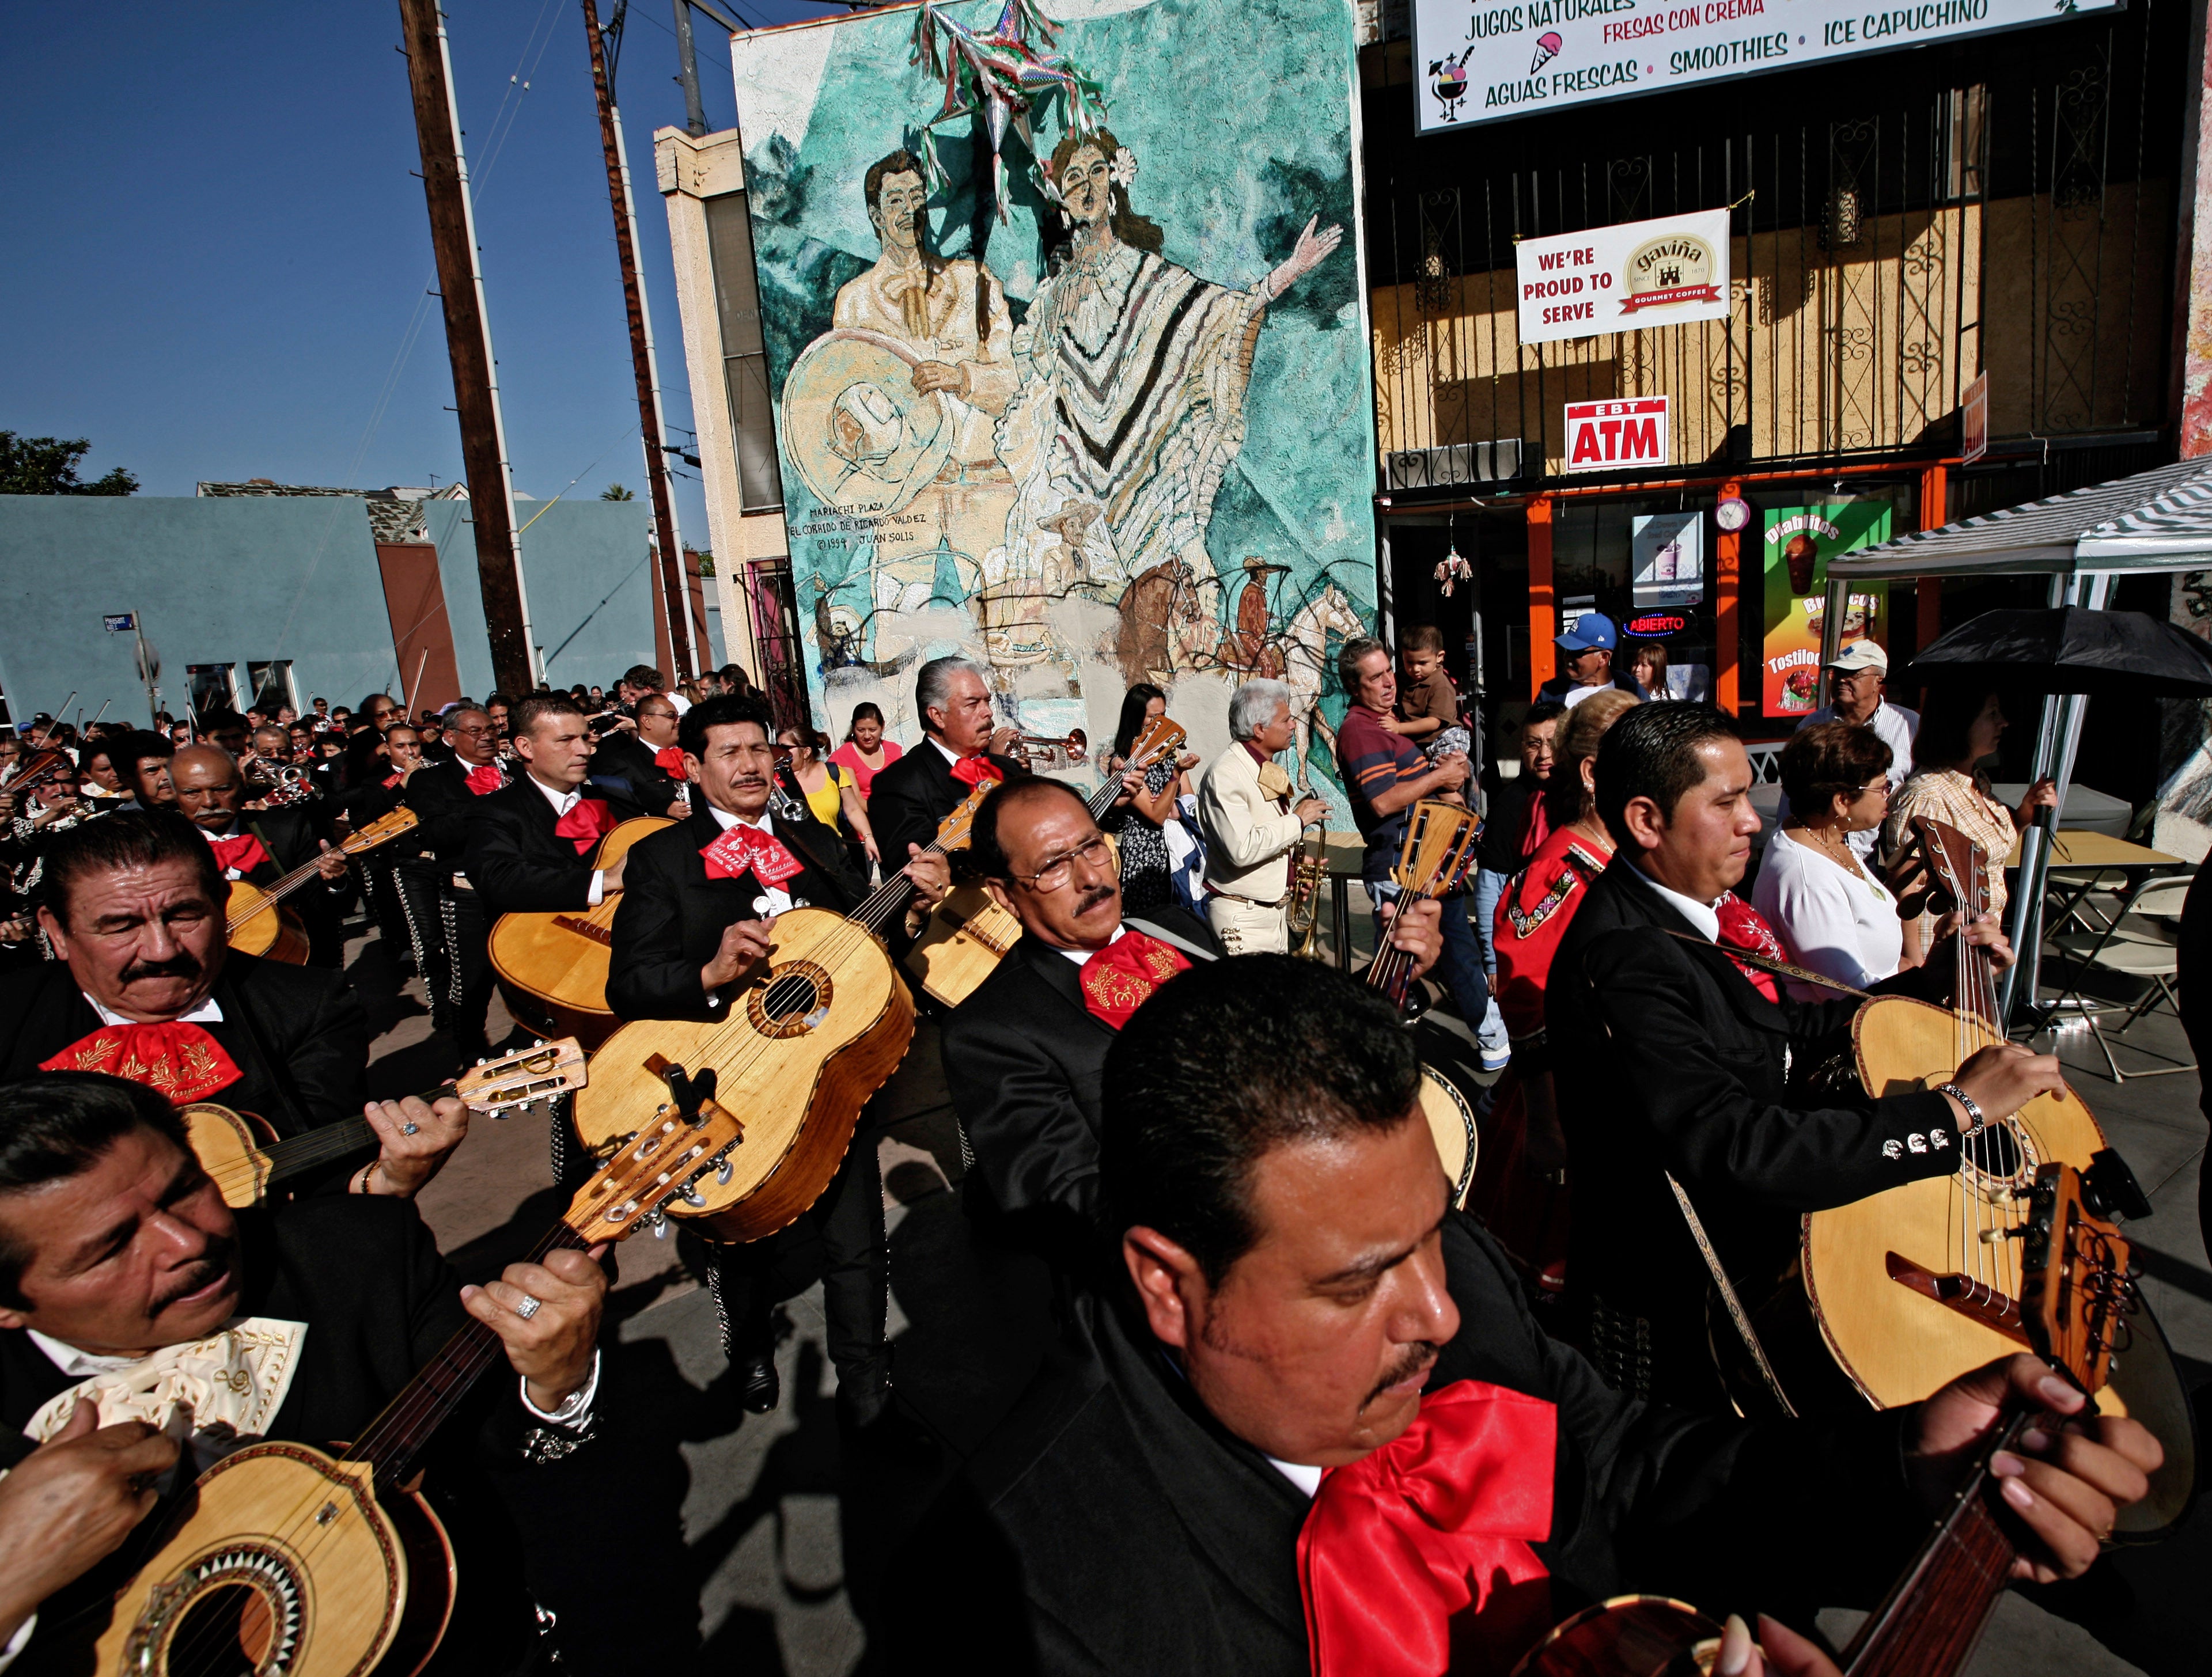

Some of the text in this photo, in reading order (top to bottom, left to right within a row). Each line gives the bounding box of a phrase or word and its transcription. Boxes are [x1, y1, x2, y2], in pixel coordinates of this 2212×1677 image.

[1465, 6, 1523, 40] JUGOS
[1604, 0, 1764, 44] FRESAS CON CREMA
[1484, 0, 1987, 108] AGUAS FRESCAS SMOOTHIES ICE CAPUCHINO
[1637, 240, 1702, 272] gaviña
[1524, 272, 1612, 301] PROUD TO
[1635, 289, 1706, 303] GOURMET COFFEE
[1543, 301, 1594, 324] SERVE
[1595, 403, 1638, 416] EBT
[1571, 418, 1660, 464] ATM
[810, 502, 884, 518] MARIACHI PLAZA
[790, 514, 926, 536] EL CORRIDO DE RICARDO VALDEZ
[1764, 514, 1839, 545] Diablitos
[859, 534, 886, 545] JUAN
[889, 532, 914, 542] SOLIS
[1802, 593, 1880, 614] Bicos
[1630, 617, 1684, 632] ABIERTO
